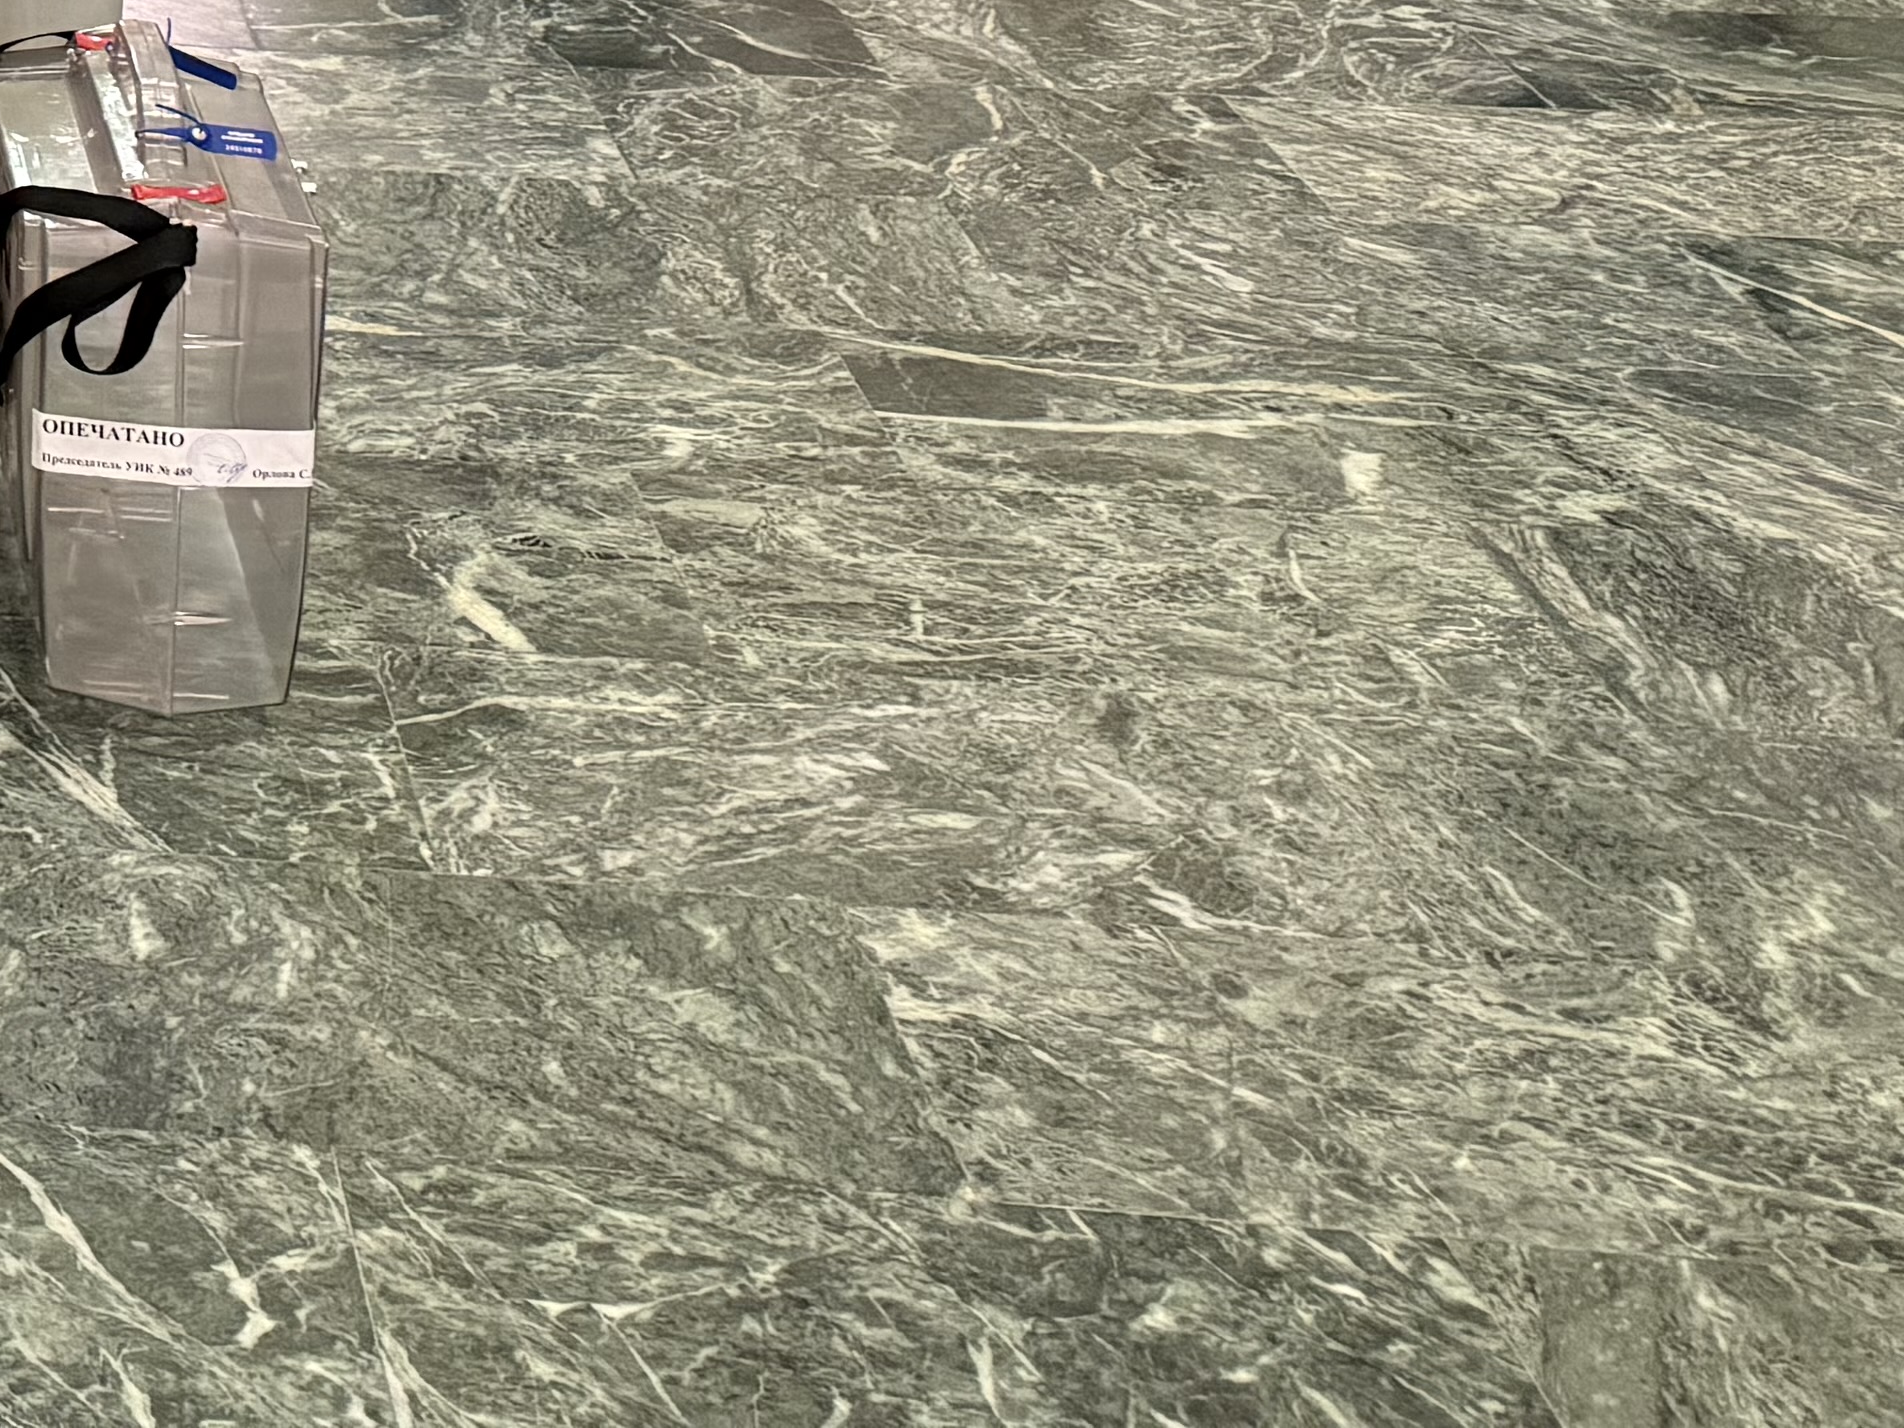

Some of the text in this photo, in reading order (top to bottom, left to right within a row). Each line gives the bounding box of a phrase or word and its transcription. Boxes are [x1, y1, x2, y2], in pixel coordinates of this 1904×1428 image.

[41, 418, 185, 448] ОПЕЧАТАНО
[41, 452, 122, 471] Председатель
[125, 461, 154, 475] УИК
[157, 464, 171, 477] №
[173, 466, 193, 477] 489
[252, 468, 296, 480] Орлова
